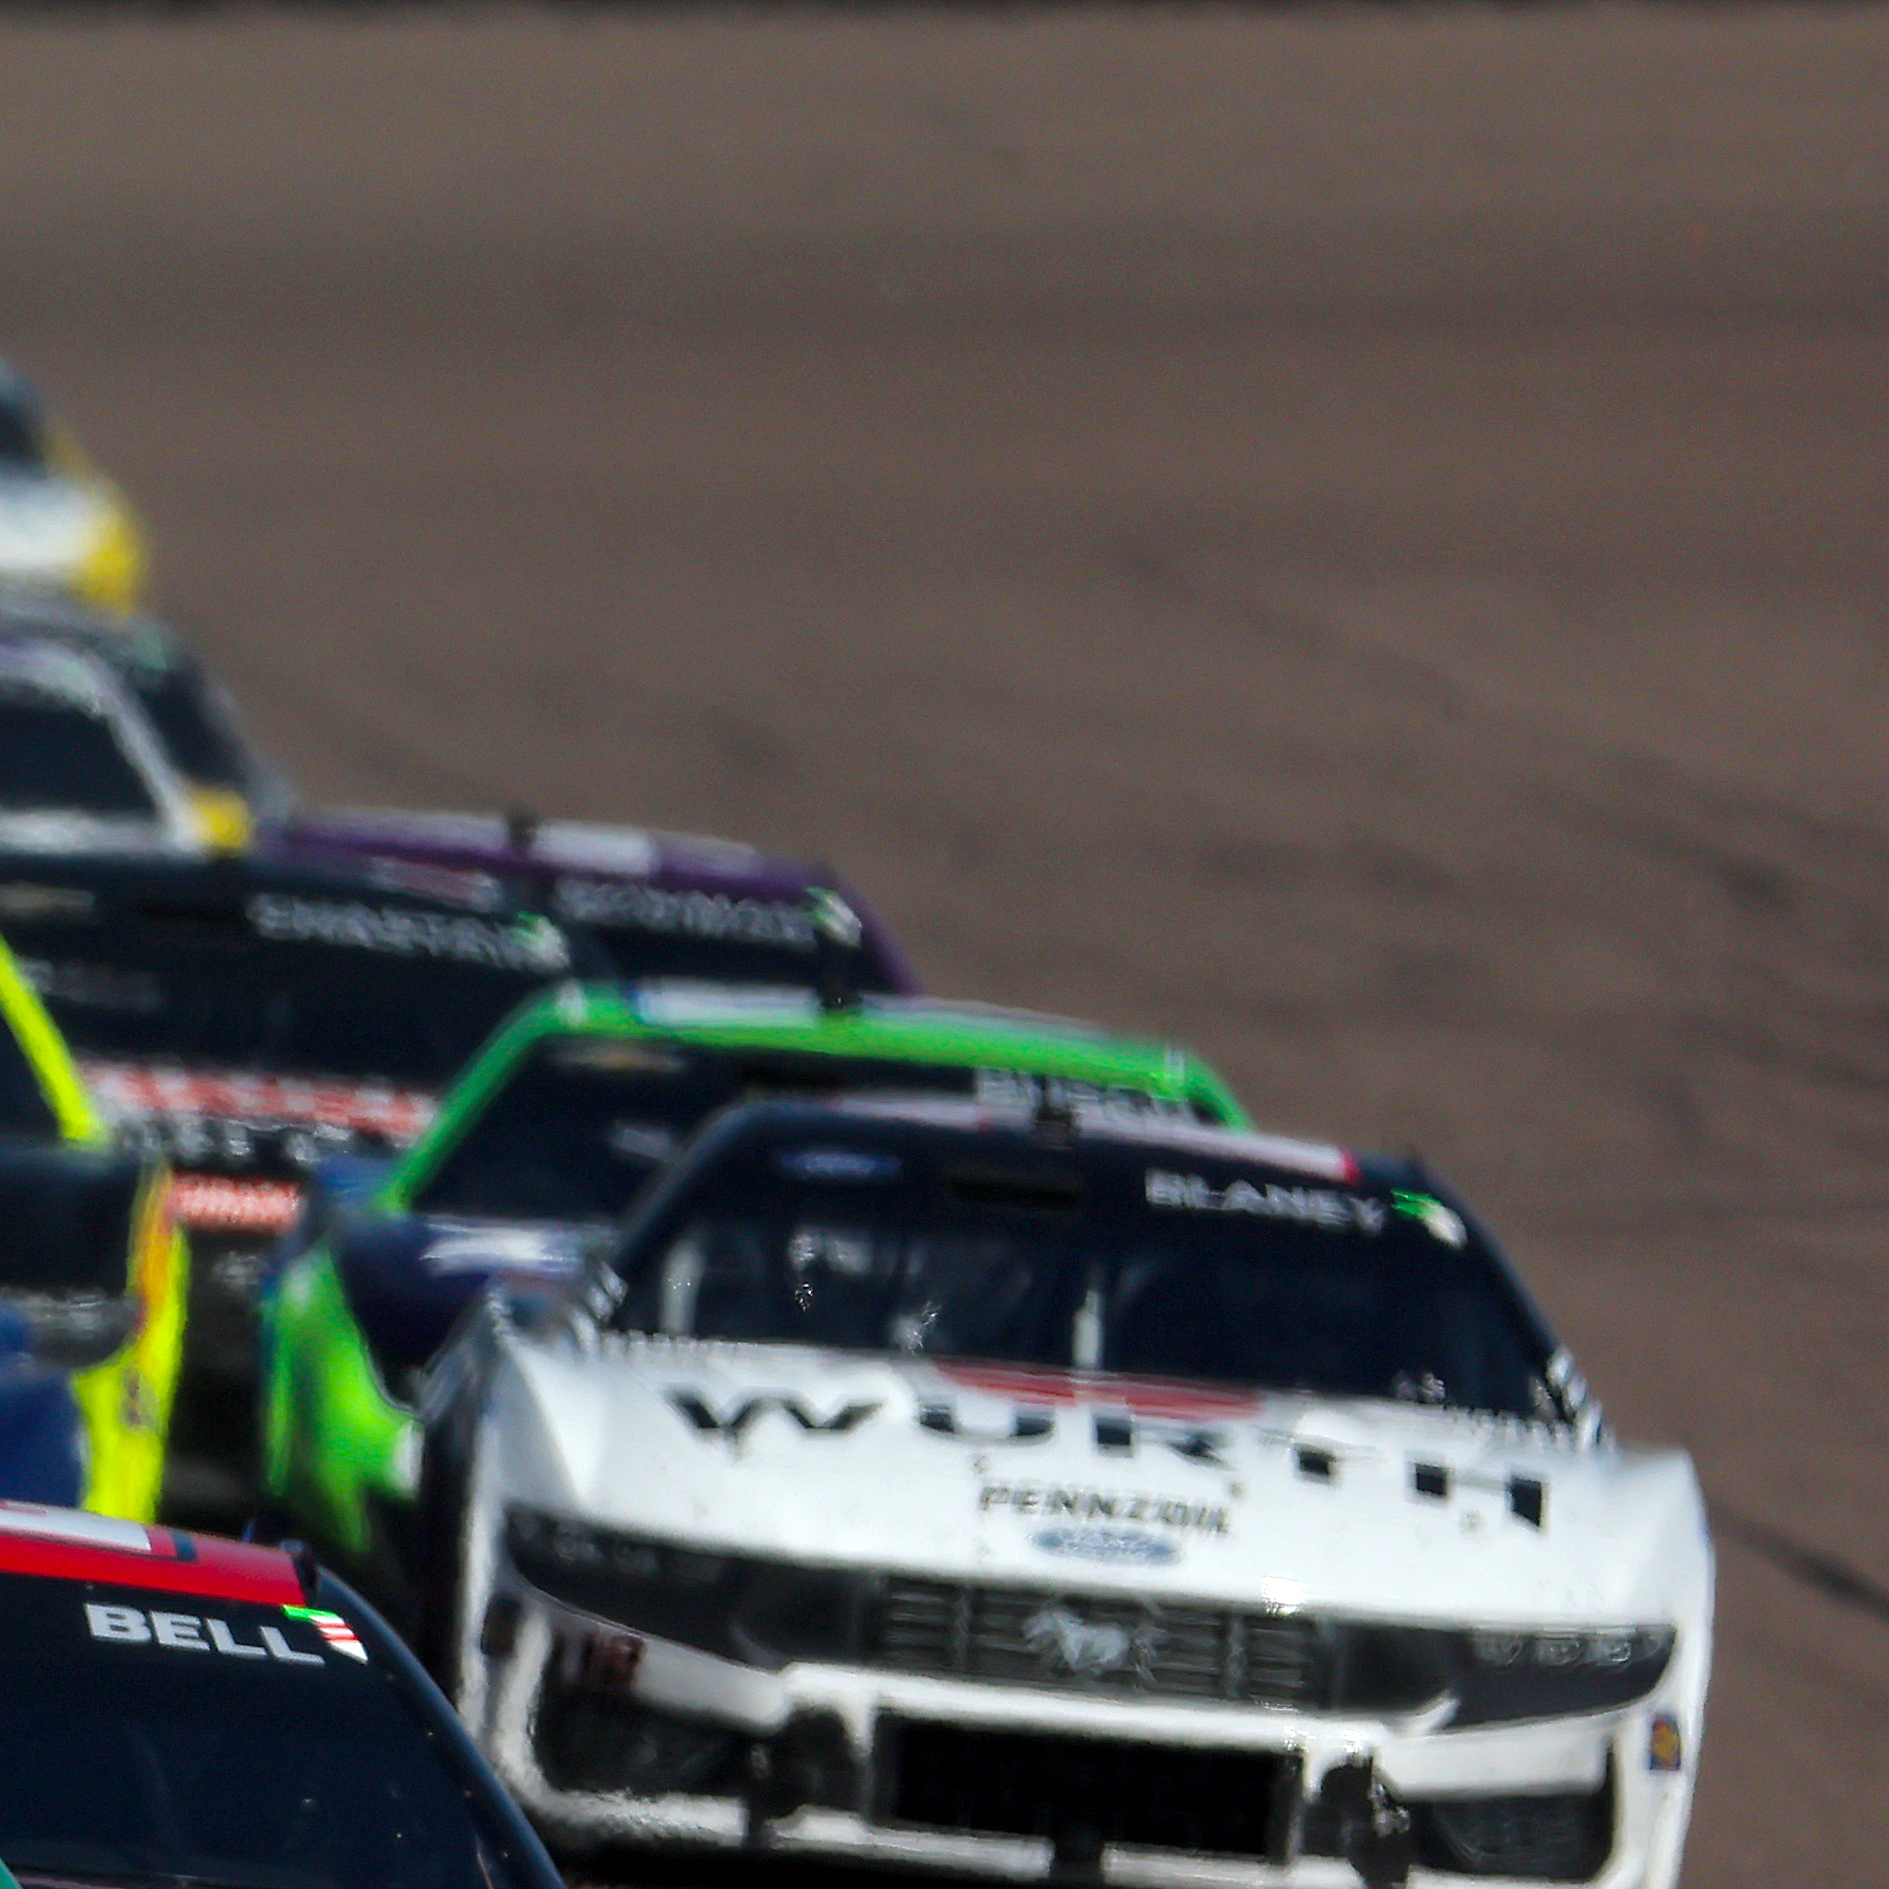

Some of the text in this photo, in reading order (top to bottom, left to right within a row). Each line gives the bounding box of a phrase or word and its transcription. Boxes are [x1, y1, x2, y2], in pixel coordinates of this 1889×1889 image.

[1146, 1169, 1385, 1232] BLANEY
[980, 1484, 1232, 1534] PENNZOIL
[84, 1602, 324, 1667] BELL
